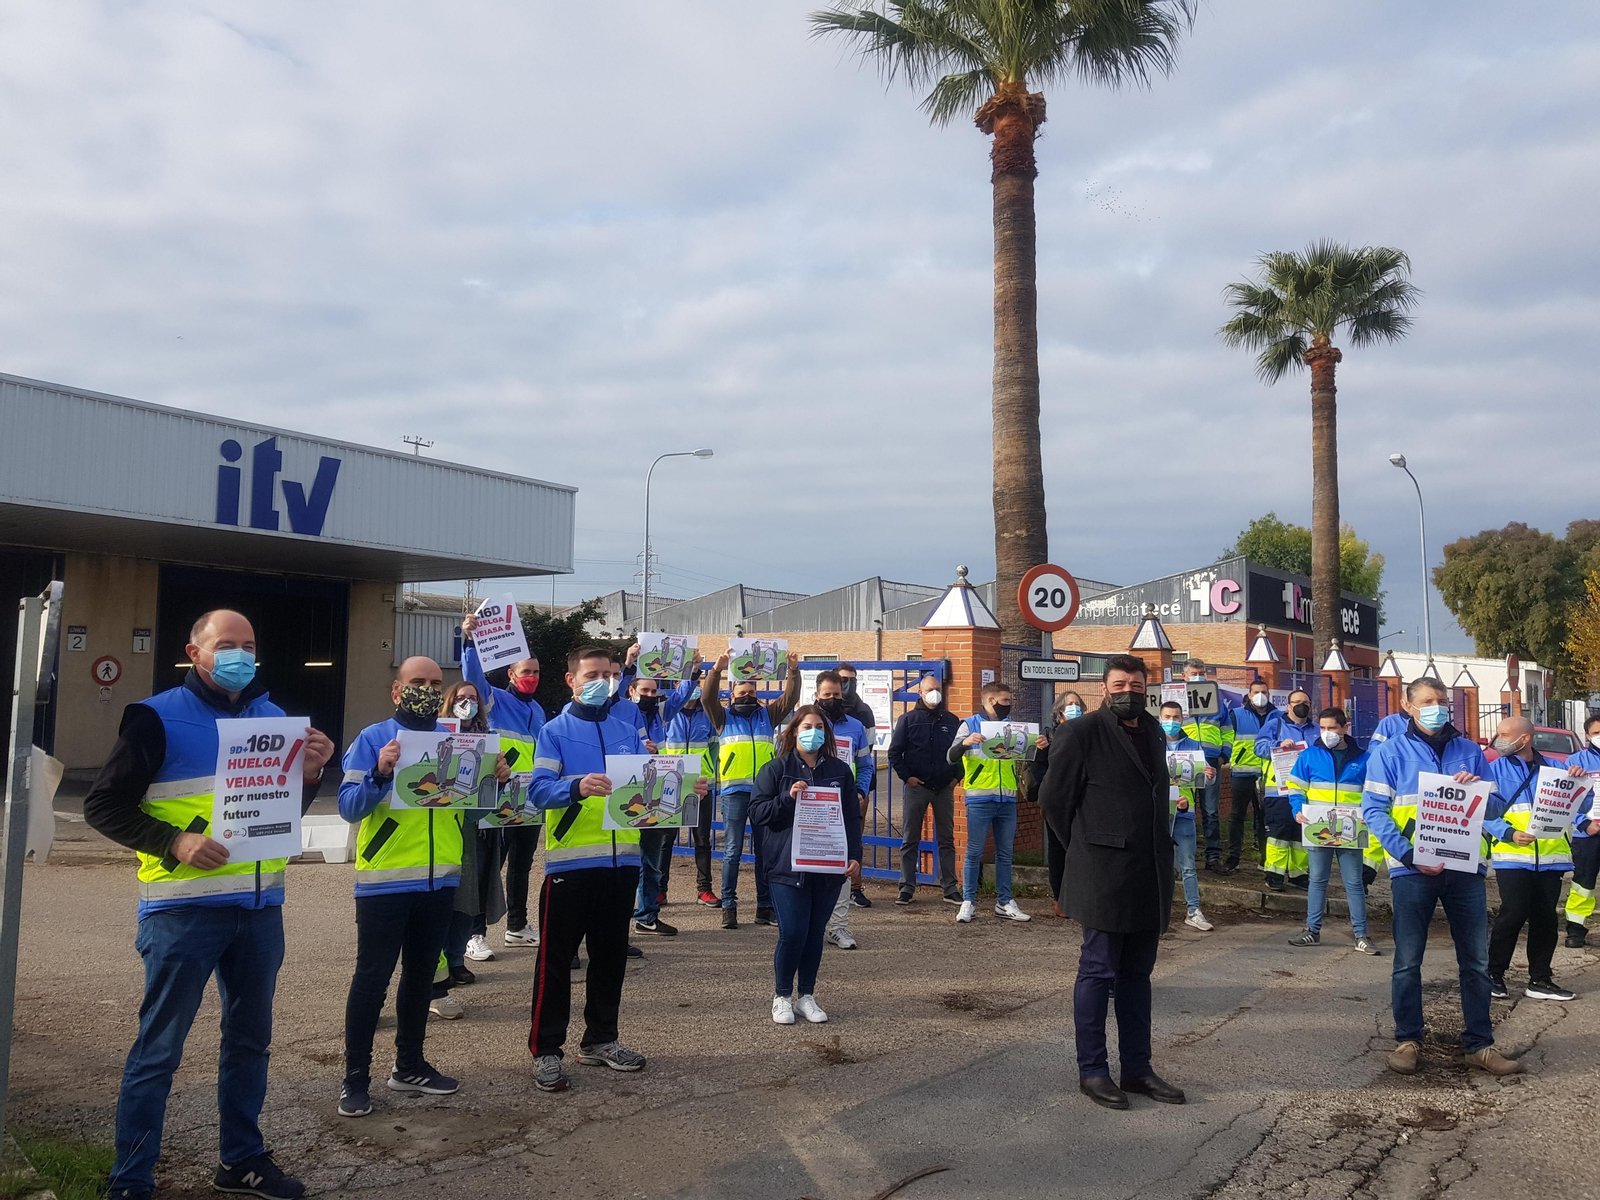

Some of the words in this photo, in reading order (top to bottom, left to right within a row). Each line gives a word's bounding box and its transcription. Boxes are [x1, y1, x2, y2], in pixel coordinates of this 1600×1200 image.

[216, 437, 342, 537] itv
[1034, 587, 1066, 609] 20
[474, 625, 504, 638] VEIASA
[73, 636, 82, 649] 2
[138, 638, 146, 651] 1
[477, 638, 488, 646] por
[488, 631, 516, 642] nuestro
[479, 644, 499, 654] futuro
[1024, 665, 1032, 674] EN
[1032, 666, 1047, 674] TODO
[1047, 666, 1053, 675] EL
[1054, 667, 1076, 675] RECINTO
[1187, 689, 1212, 709] itv
[227, 756, 281, 770] HUELGA
[225, 774, 274, 789] VEIASA
[223, 793, 244, 805] por
[246, 789, 290, 802] nuestro
[1540, 787, 1571, 800] HUELGA
[1422, 799, 1465, 814] HUELGA
[1538, 797, 1565, 809] VEIASA
[223, 808, 260, 820] futuro
[1421, 812, 1459, 825] VEIASA
[1548, 807, 1571, 817] nuestro
[1533, 815, 1553, 823] futuro
[1420, 823, 1435, 831] por
[1436, 824, 1471, 837] nuestro
[1419, 833, 1446, 844] futuro
